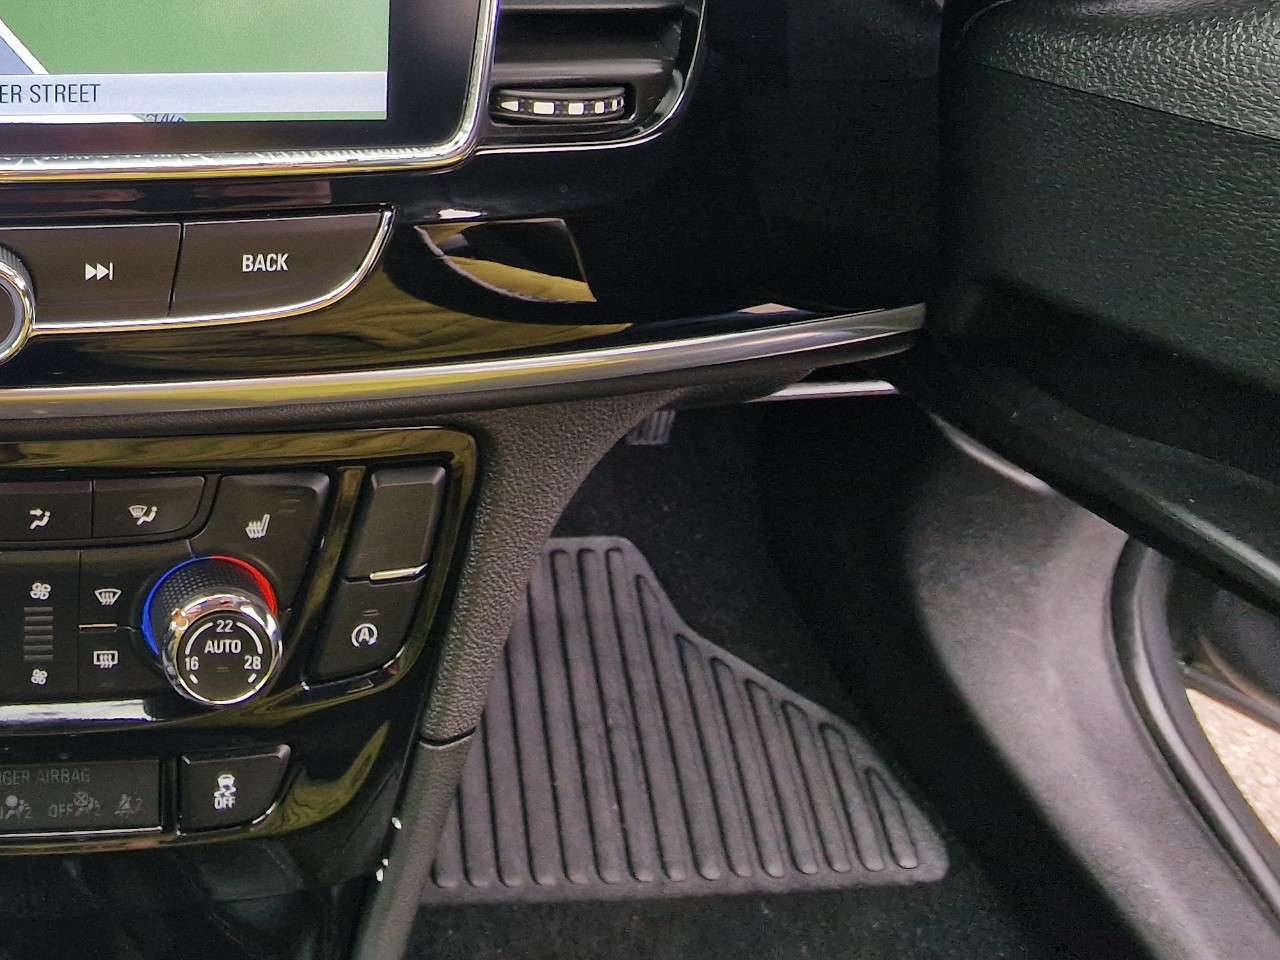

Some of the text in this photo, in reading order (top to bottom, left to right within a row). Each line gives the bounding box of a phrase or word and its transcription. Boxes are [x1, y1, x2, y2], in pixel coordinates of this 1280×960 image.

[29, 83, 101, 103] STREET
[242, 253, 289, 272] BACK
[215, 619, 234, 633] 22
[204, 639, 242, 654] AUTO
[184, 656, 200, 671] 16
[243, 655, 262, 670] 28
[34, 767, 91, 784] AIRBAG
[213, 797, 236, 809] OFF
